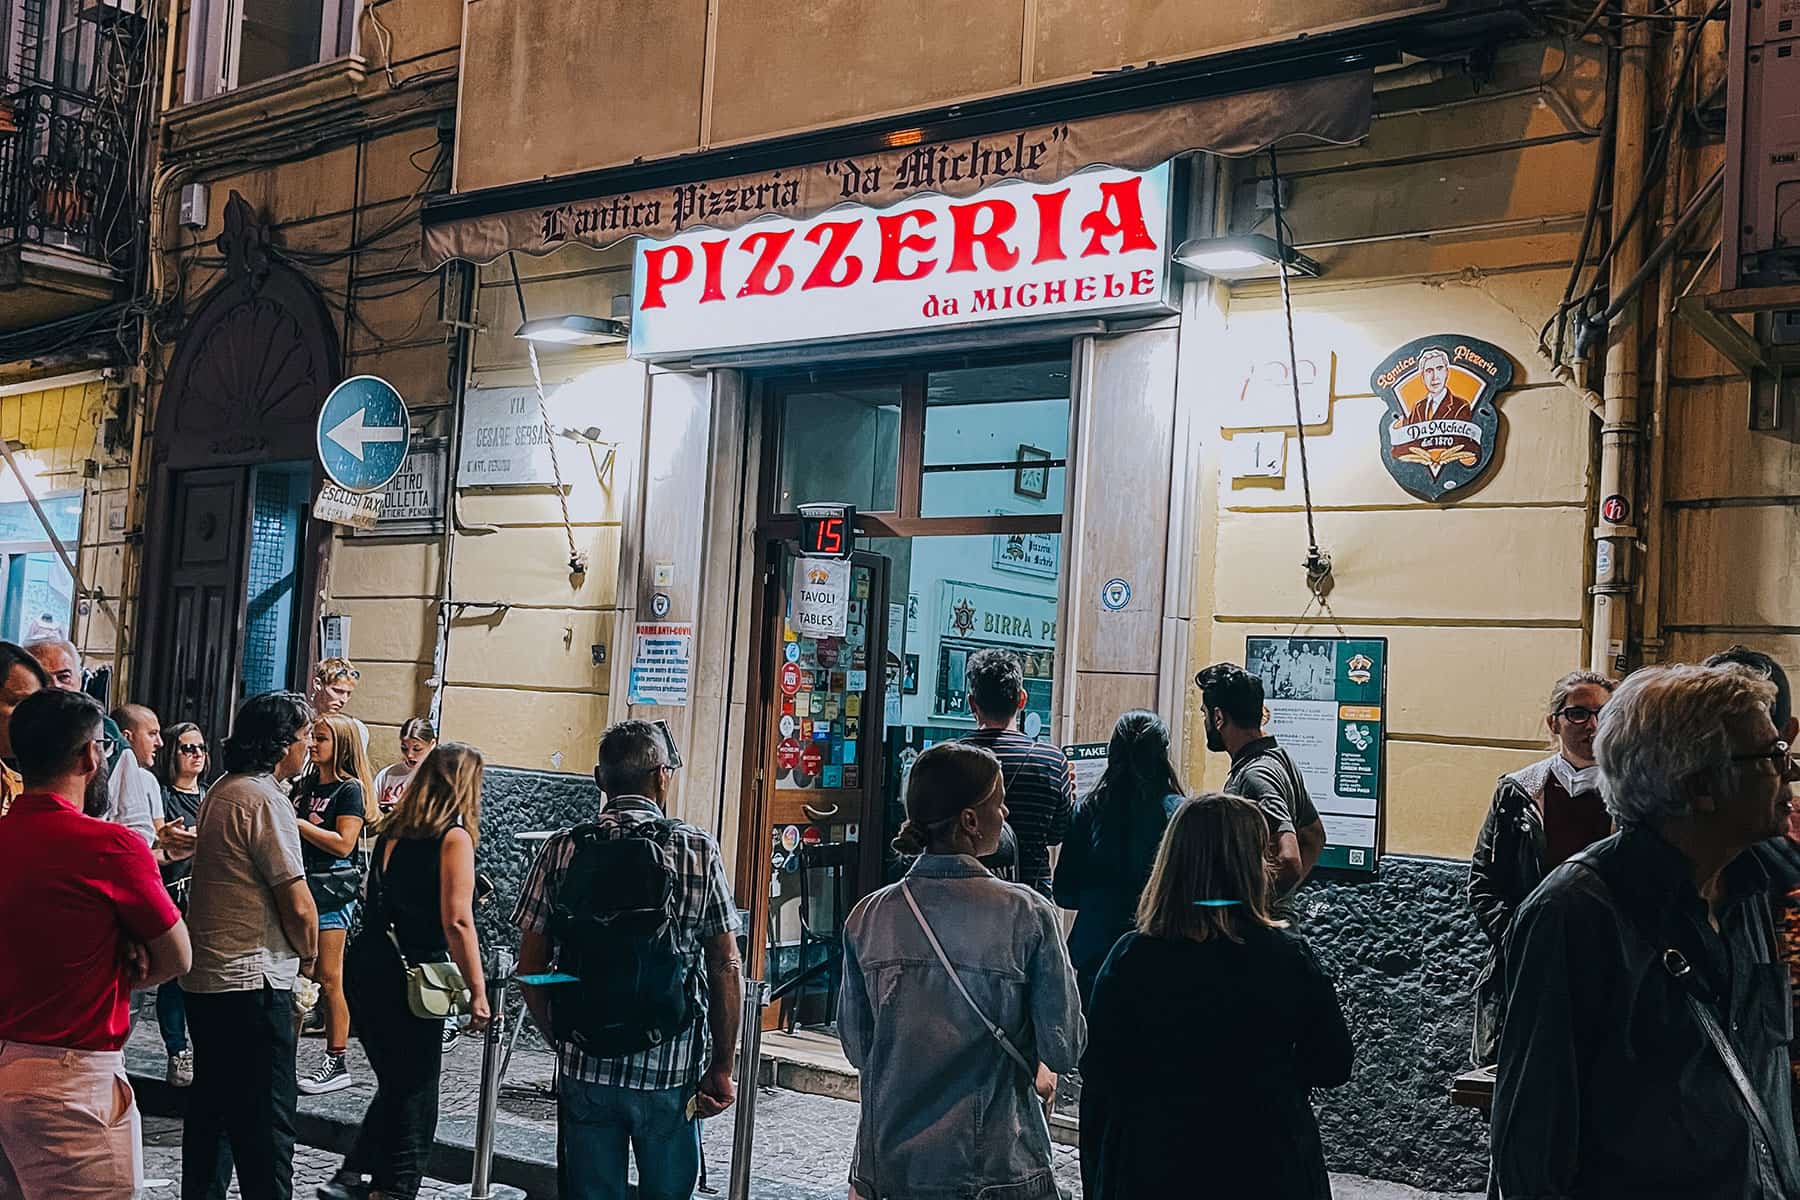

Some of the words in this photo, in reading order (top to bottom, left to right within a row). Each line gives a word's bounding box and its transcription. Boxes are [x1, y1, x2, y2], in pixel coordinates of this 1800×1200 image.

[541, 194, 662, 245] L'antica
[671, 171, 800, 232] Pizzeria
[640, 175, 1158, 312] PIZZERIA
[922, 294, 960, 318] da
[1453, 345, 1498, 377] Pizzeria
[509, 396, 526, 415] VIA
[476, 426, 511, 448] CESARE
[1407, 424, 1427, 440] Da
[1428, 420, 1474, 436] Michele
[816, 518, 843, 553] 15
[800, 590, 836, 605] TAVOLI
[799, 612, 834, 626] TABLES
[983, 611, 1034, 639] BIRRA
[1079, 746, 1107, 757] TAKE
